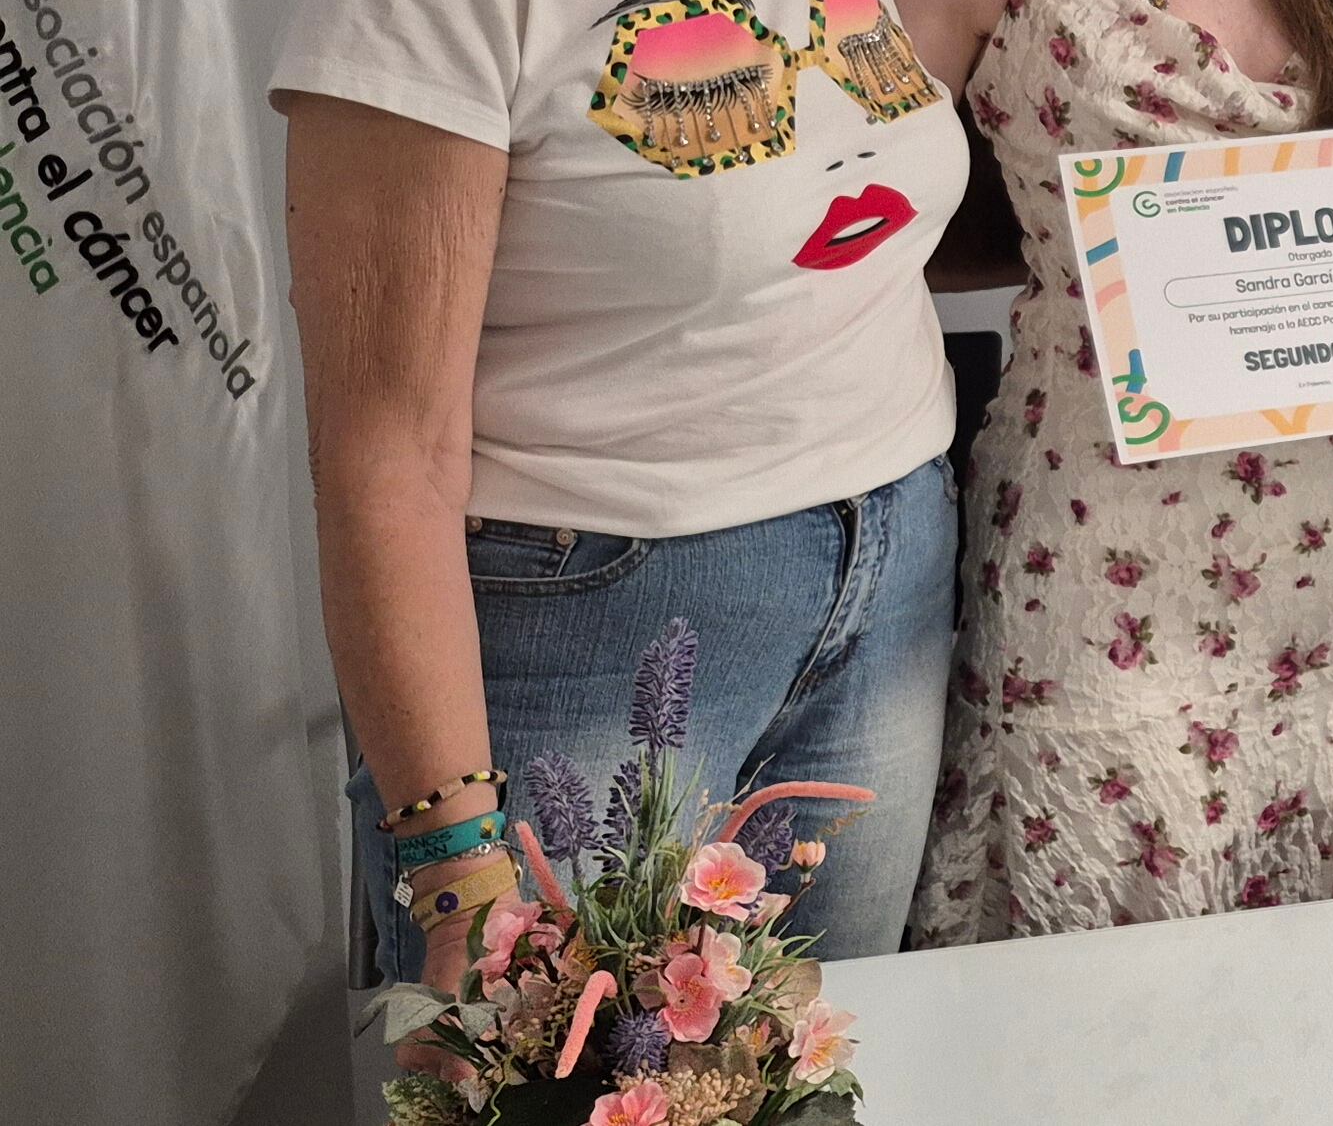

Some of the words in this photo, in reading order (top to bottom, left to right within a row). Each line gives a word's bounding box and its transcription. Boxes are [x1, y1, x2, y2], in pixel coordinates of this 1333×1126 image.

[0, 19, 50, 143] ntra
[37, 153, 93, 201] el
[1288, 249, 1333, 262] Otorgado
[63, 210, 179, 354] cáncer
[1235, 277, 1290, 294] Sandra
[141, 209, 256, 400] española
[1188, 313, 1205, 323] Por
[1208, 314, 1221, 322] su
[1222, 303, 1287, 323] participación
[1288, 304, 1300, 312] en
[1302, 301, 1311, 311] el
[1229, 322, 1276, 336] homenaje
[1278, 322, 1285, 330] a
[1286, 319, 1296, 330] la
